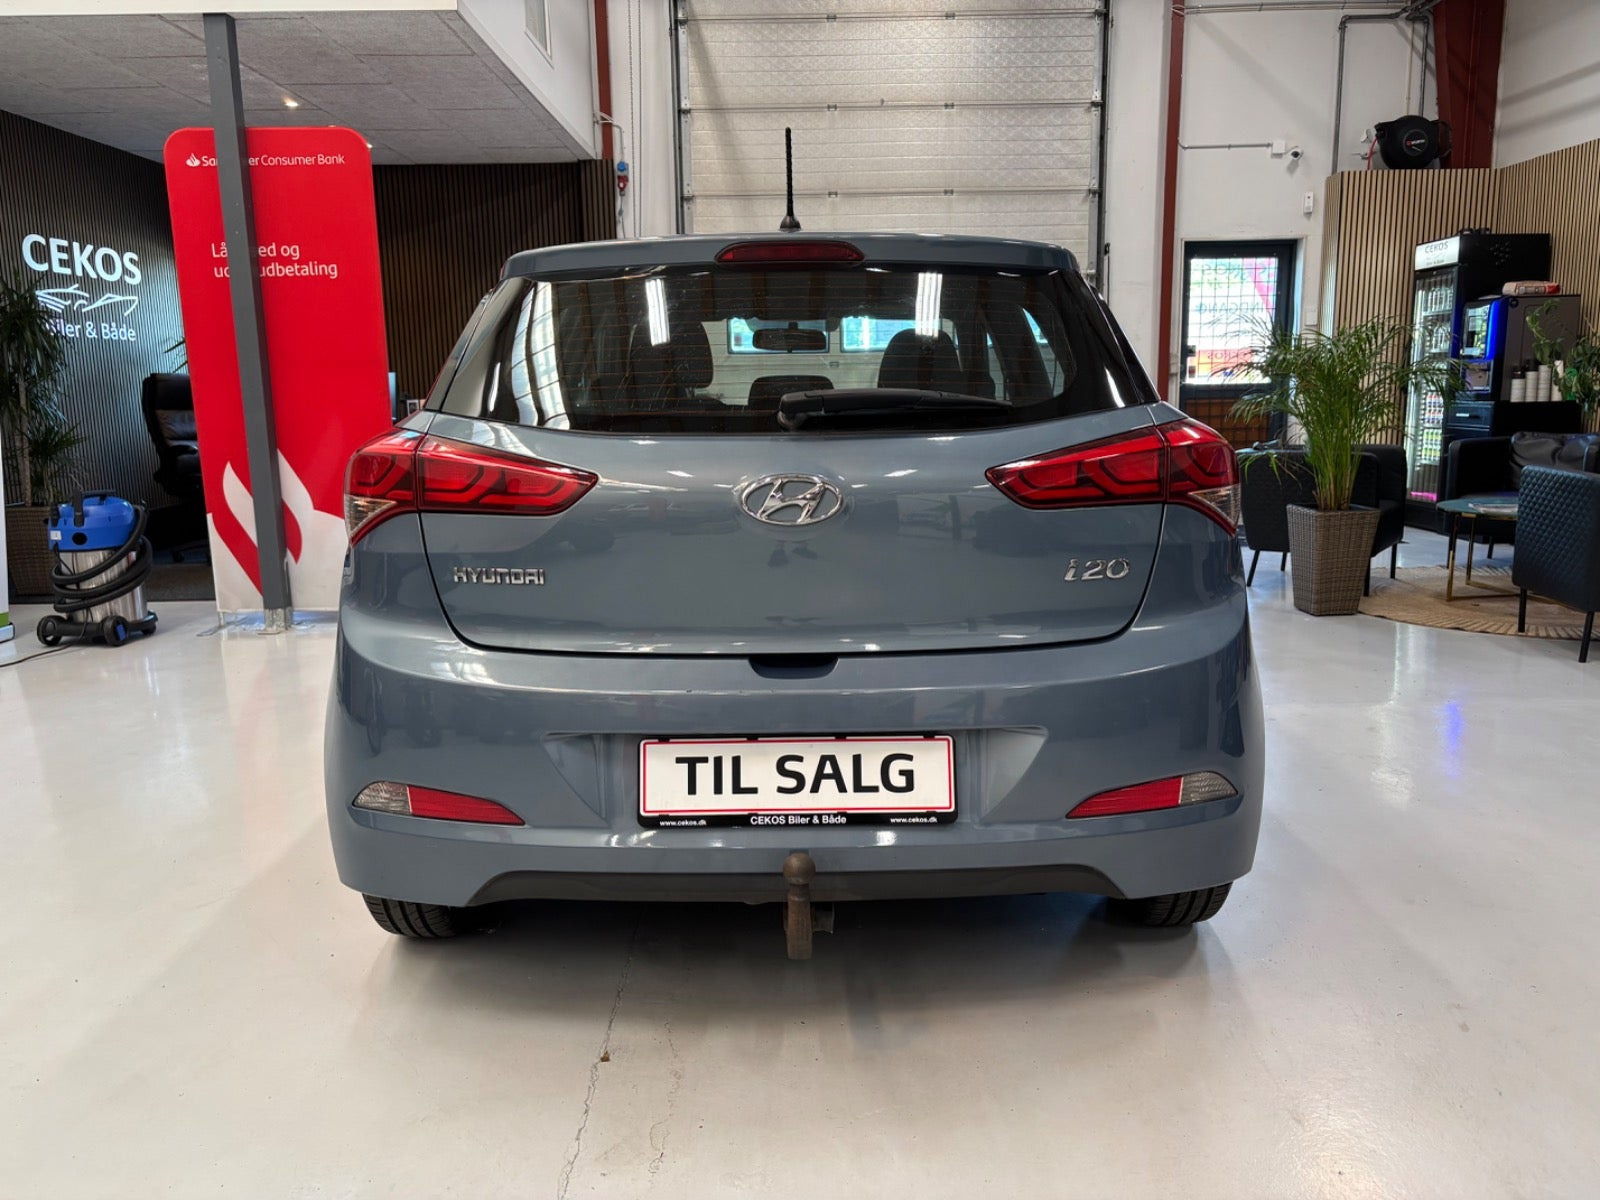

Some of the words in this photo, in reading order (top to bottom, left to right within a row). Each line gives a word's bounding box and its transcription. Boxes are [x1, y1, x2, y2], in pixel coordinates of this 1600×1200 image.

[260, 154, 316, 166] Consumer
[317, 153, 345, 165] Bank
[22, 233, 142, 285] CEKOS
[211, 241, 228, 258] Lå
[257, 242, 277, 257] ed
[280, 244, 300, 259] og
[86, 321, 98, 338] &
[101, 321, 136, 341] Både
[453, 566, 546, 585] HYUNDAI
[1064, 558, 1130, 581] i20
[675, 755, 759, 796] TIL
[776, 753, 915, 794] SALG
[659, 819, 707, 827] www.cekos.dk
[750, 815, 786, 826] CEKOS
[788, 814, 810, 825] Biler
[812, 814, 820, 825] &
[822, 814, 847, 825] Både
[889, 816, 938, 825] www.cekos.dk
